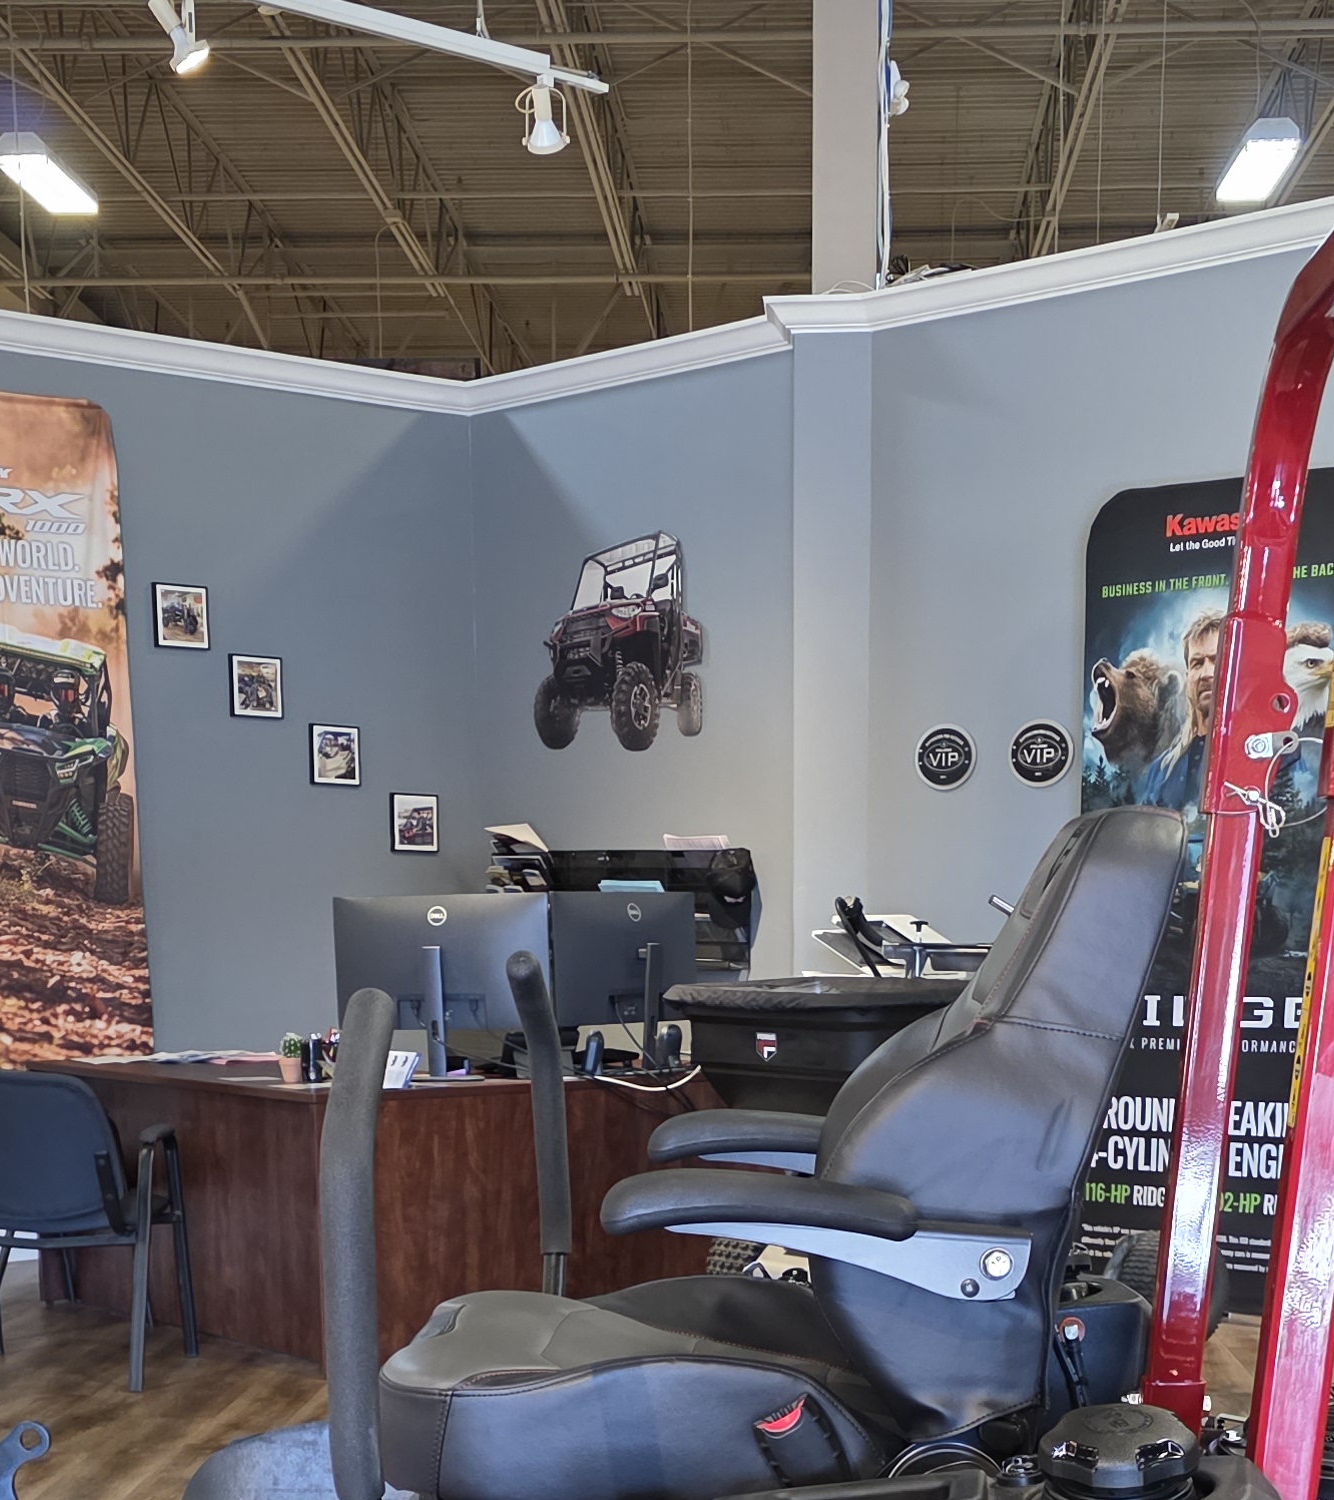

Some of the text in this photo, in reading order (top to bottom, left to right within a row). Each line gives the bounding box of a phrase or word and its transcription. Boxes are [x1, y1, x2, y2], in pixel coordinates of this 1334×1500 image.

[25, 519, 86, 535] 1000
[1165, 512, 1241, 538] Kawas
[1185, 539, 1200, 551] the
[1201, 537, 1226, 550] Good
[1101, 581, 1152, 598] BUSINESS
[1155, 579, 1166, 593] IN
[1169, 576, 1189, 591] THE
[1192, 573, 1229, 589] FRONT.
[1293, 565, 1308, 579] HE
[929, 752, 959, 767] VIP
[1023, 748, 1055, 763] VIP
[1141, 1037, 1181, 1051] PREMI
[1241, 1039, 1296, 1053] ORMANC
[1133, 1185, 1165, 1208] RIDG
[1219, 1191, 1261, 1215] 2-HP
